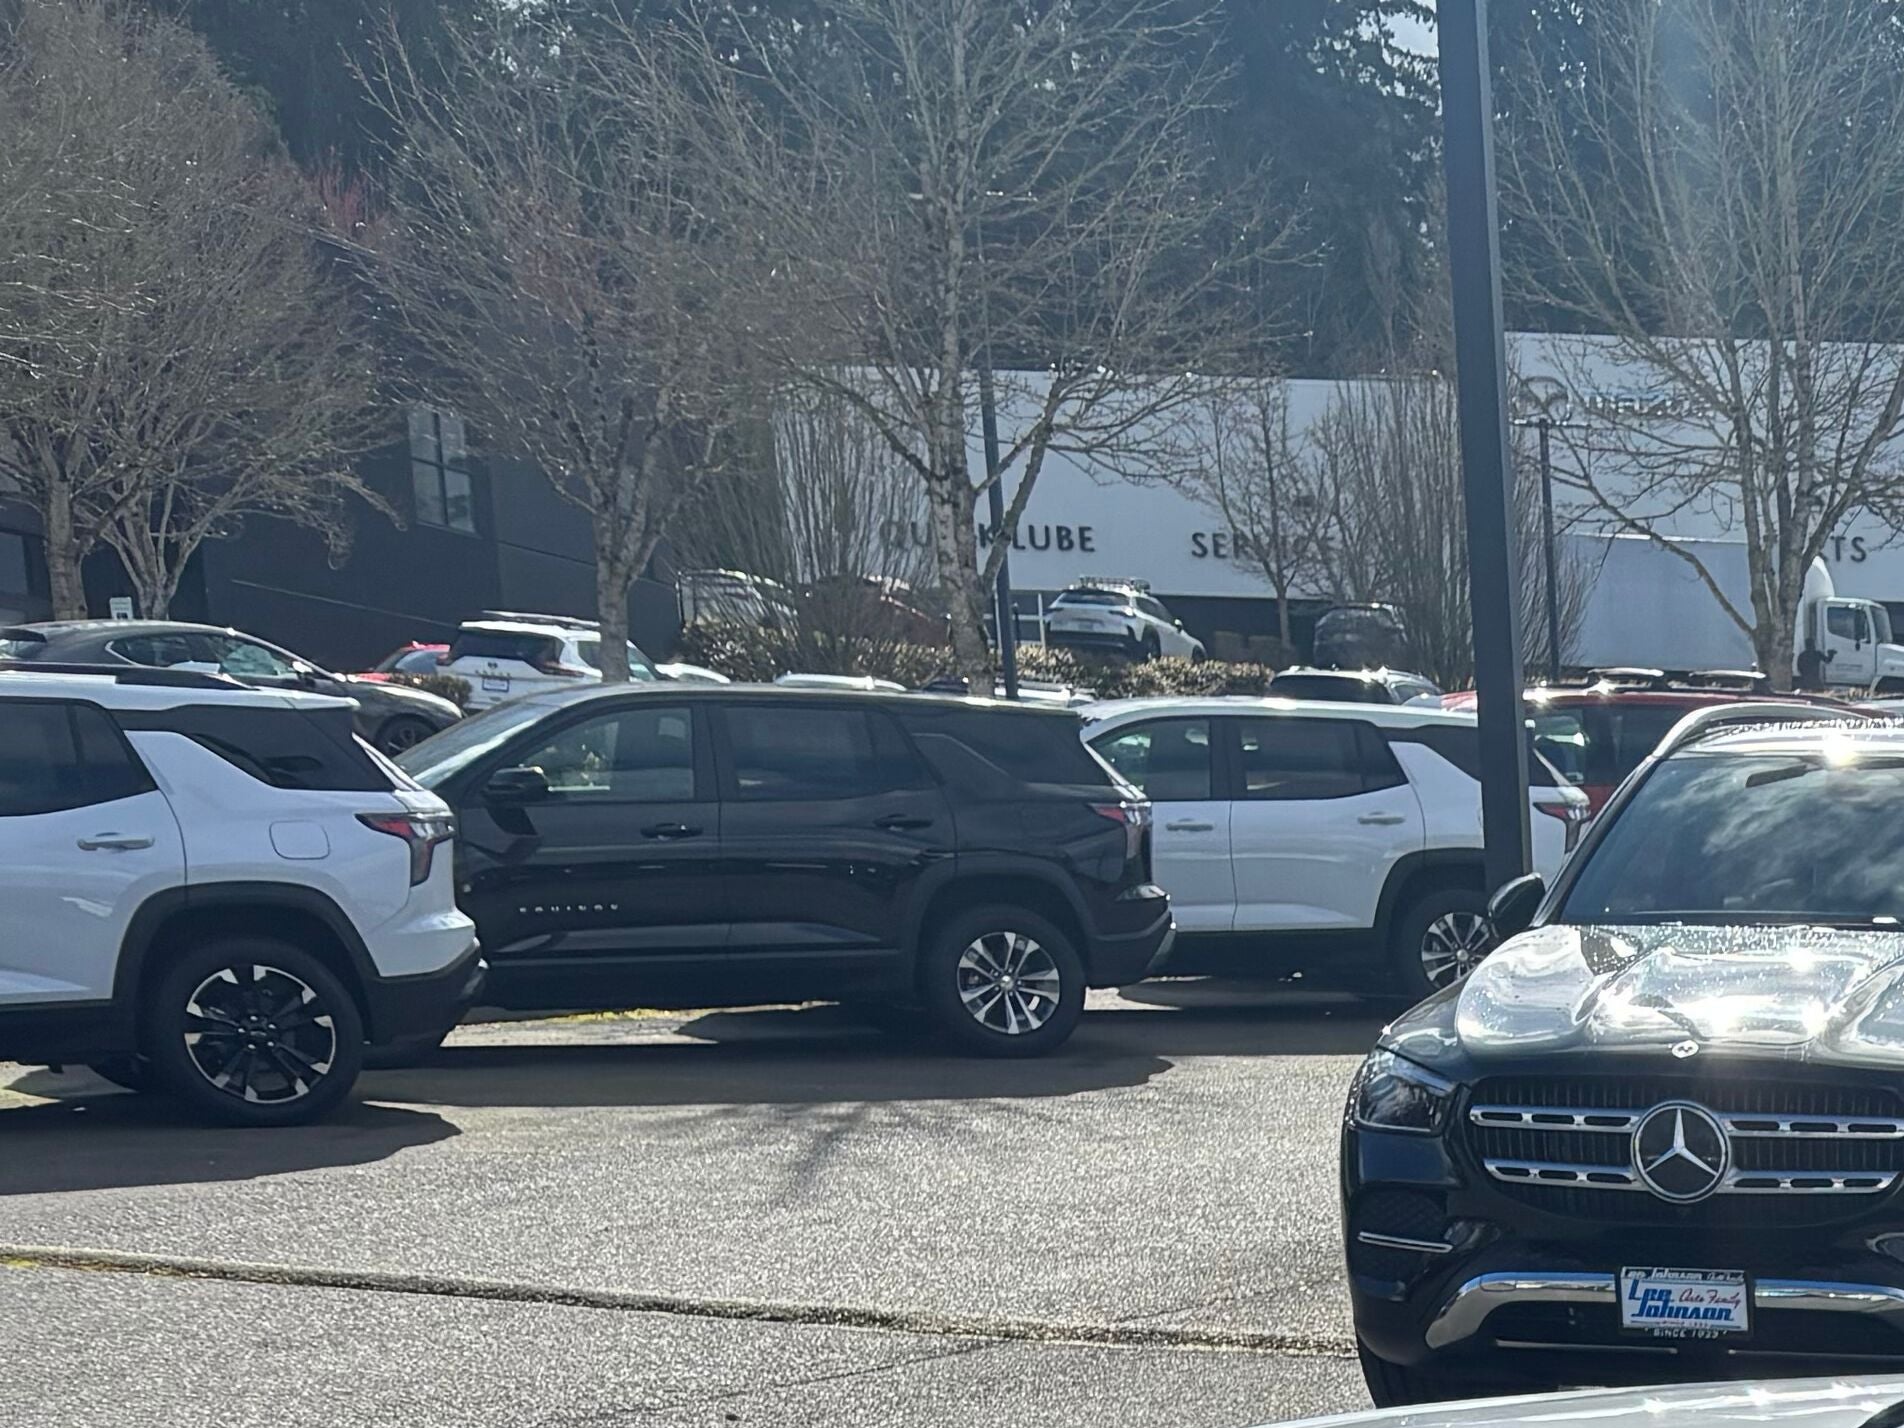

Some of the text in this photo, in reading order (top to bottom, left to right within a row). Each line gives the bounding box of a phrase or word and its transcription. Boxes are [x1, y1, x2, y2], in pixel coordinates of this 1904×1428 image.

[1012, 524, 1096, 553] LUBE
[1628, 1279, 1675, 1303] Lee
[1630, 1297, 1735, 1322] Johnson
